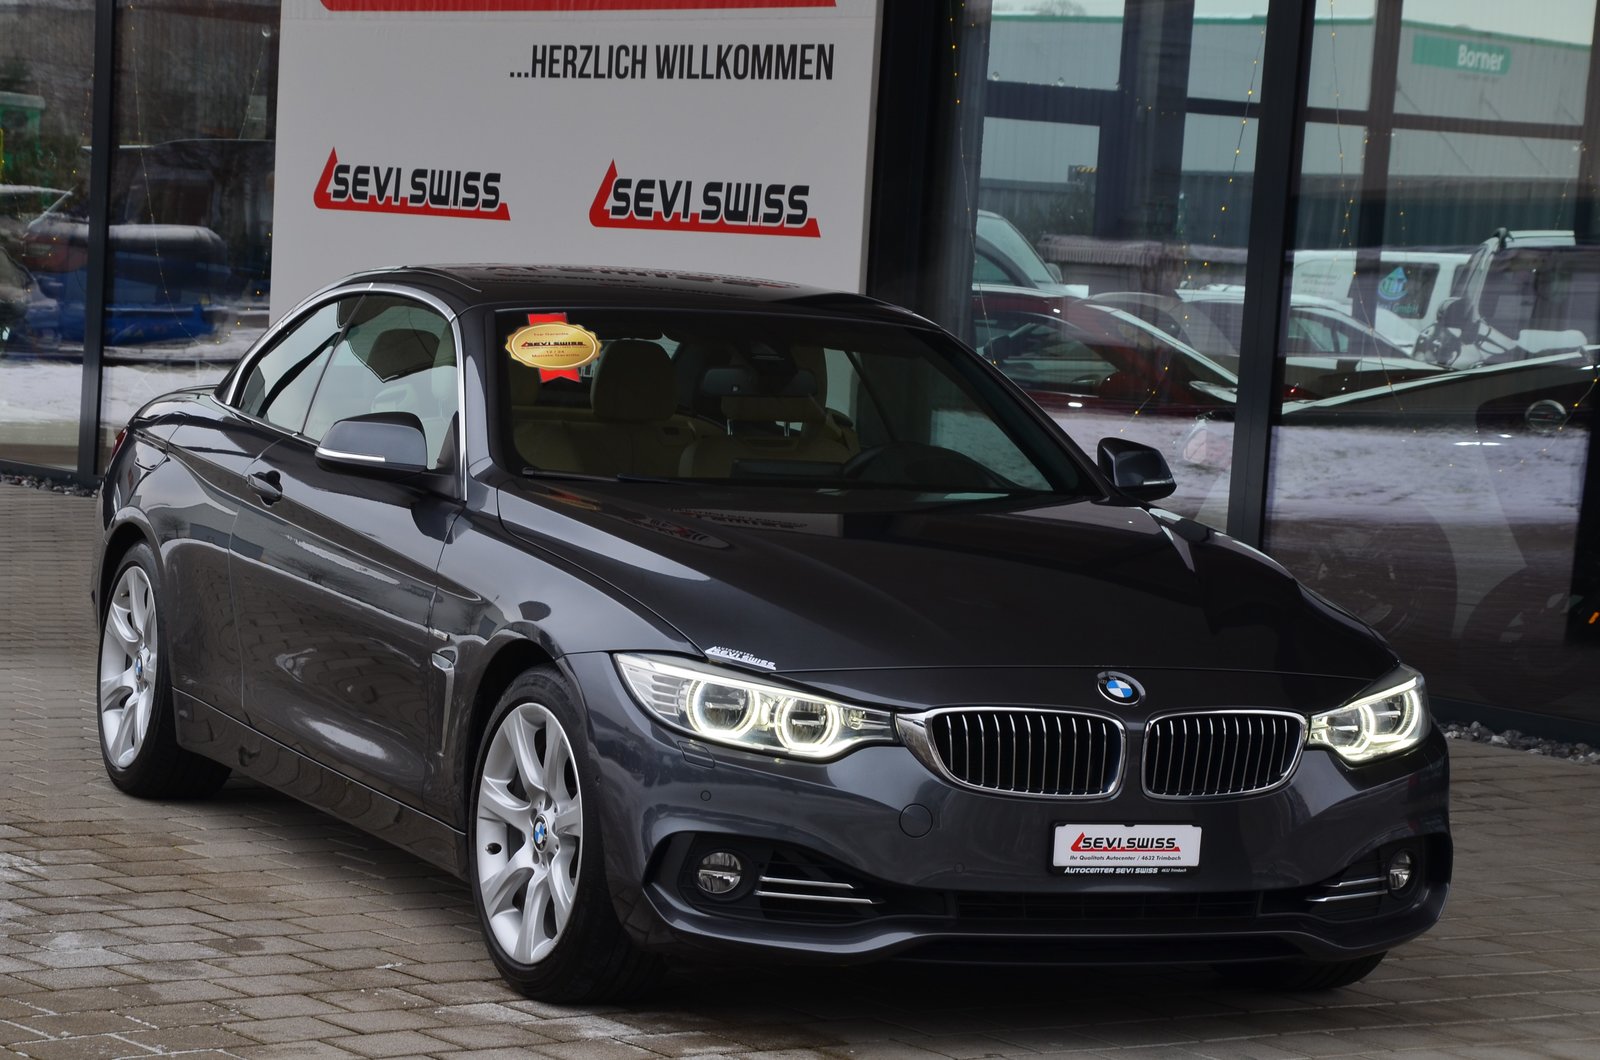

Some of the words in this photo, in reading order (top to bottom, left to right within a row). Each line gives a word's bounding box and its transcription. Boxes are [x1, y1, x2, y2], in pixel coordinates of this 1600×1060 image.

[509, 44, 647, 80] ...HERZLICH
[655, 43, 835, 80] WILLKOMMEN
[1457, 44, 1504, 71] Borner
[331, 163, 401, 204] SEVI
[408, 167, 502, 210] SWISS
[609, 177, 691, 220] SEVI
[700, 181, 810, 227] SWISS
[1081, 837, 1122, 849] SEVI
[1126, 837, 1176, 849] SWISS
